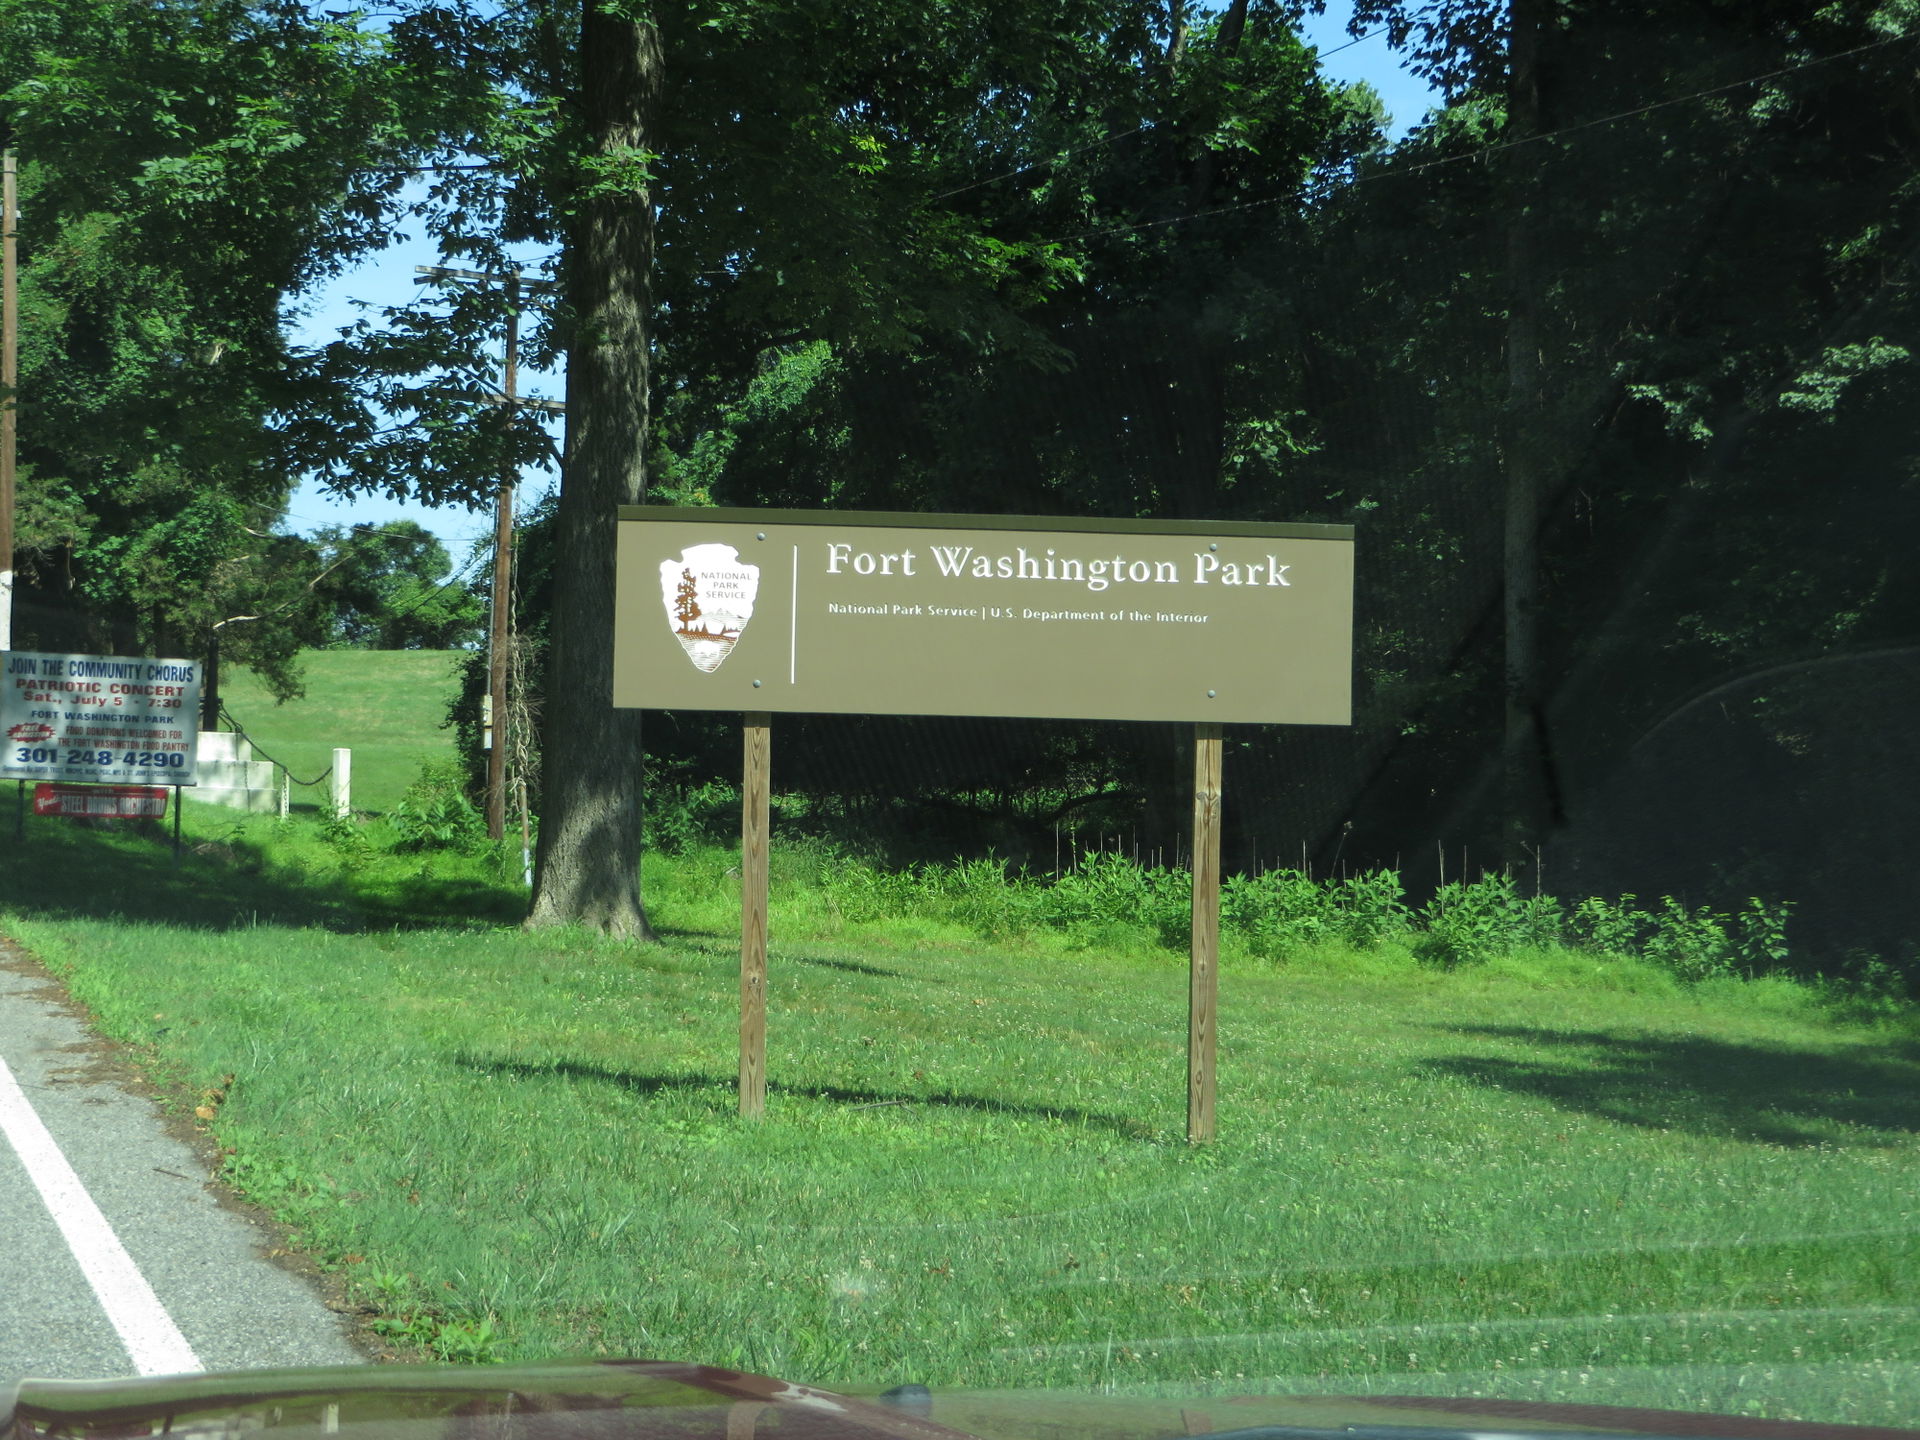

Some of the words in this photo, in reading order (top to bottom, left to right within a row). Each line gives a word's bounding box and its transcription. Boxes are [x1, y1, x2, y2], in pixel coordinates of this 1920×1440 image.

[825, 542, 918, 576] Fort
[929, 545, 1180, 592] Washington
[1193, 552, 1292, 588] Park
[701, 571, 752, 582] NATIONAL
[713, 580, 740, 590] PARK
[705, 590, 747, 600] SERVICE
[828, 602, 888, 615] National
[892, 603, 923, 616] Park
[927, 604, 979, 617] Service
[990, 606, 1018, 619] U.S.
[1023, 608, 1105, 623] Department
[1109, 609, 1124, 621] of
[1129, 610, 1152, 622] the
[1156, 611, 1209, 624] Interior
[8, 657, 37, 675] JOIN
[42, 659, 64, 676] THE
[69, 660, 143, 681] COMMUNITY
[147, 664, 194, 683] CHORUS
[16, 678, 102, 692] PATRIOTIC
[109, 682, 185, 697] CONCERT
[23, 690, 62, 704] Sat.,
[70, 694, 107, 708] July
[113, 696, 123, 706] 5
[147, 697, 182, 708] 7:30
[31, 709, 59, 719] FORT
[64, 712, 140, 723] WASHINGTON
[144, 714, 174, 724] PARK
[86, 727, 126, 738] DONATIONS
[168, 731, 183, 740] FOR
[58, 737, 71, 747] THE
[73, 738, 91, 748] FORT
[94, 739, 140, 750] WASHINGTON
[142, 741, 160, 751] FOOD
[161, 742, 190, 752] PANTRY
[16, 747, 185, 768] 301-248-4290
